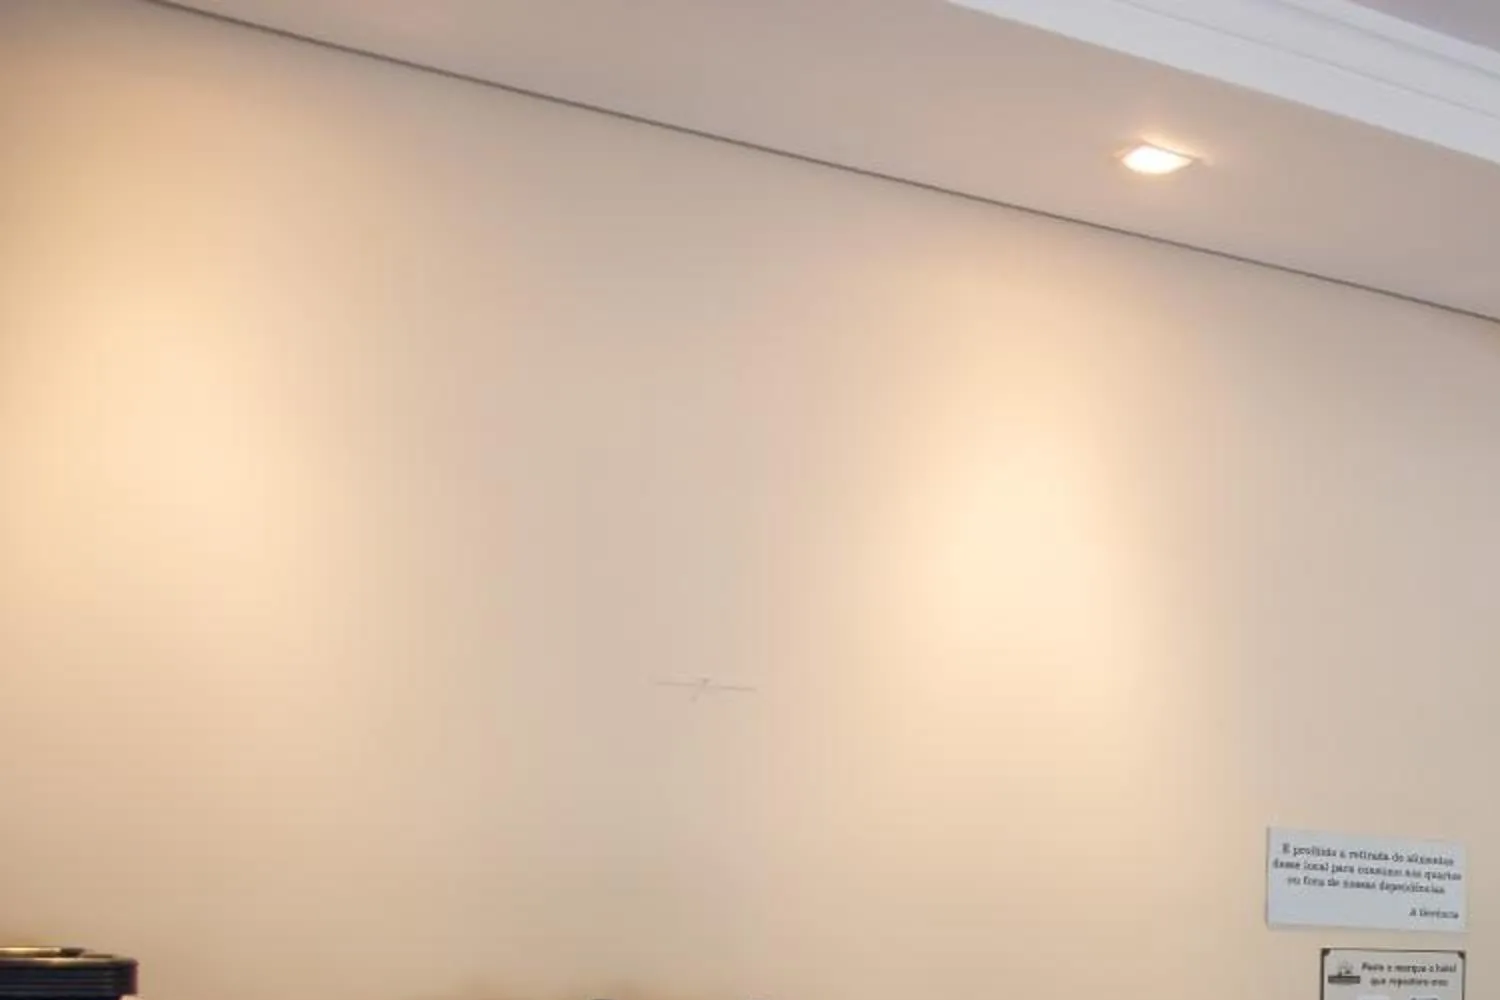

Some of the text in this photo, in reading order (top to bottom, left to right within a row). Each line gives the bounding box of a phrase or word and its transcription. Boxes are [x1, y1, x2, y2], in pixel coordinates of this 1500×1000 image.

[1348, 850, 1389, 861] retirada
[1391, 852, 1405, 863] de
[1302, 860, 1329, 872] local
[1330, 863, 1355, 874] para
[1423, 871, 1462, 881] quartos
[1302, 875, 1325, 887] fora
[1326, 878, 1340, 888] de
[1395, 963, 1427, 975] marque
[1435, 963, 1457, 973] hotel
